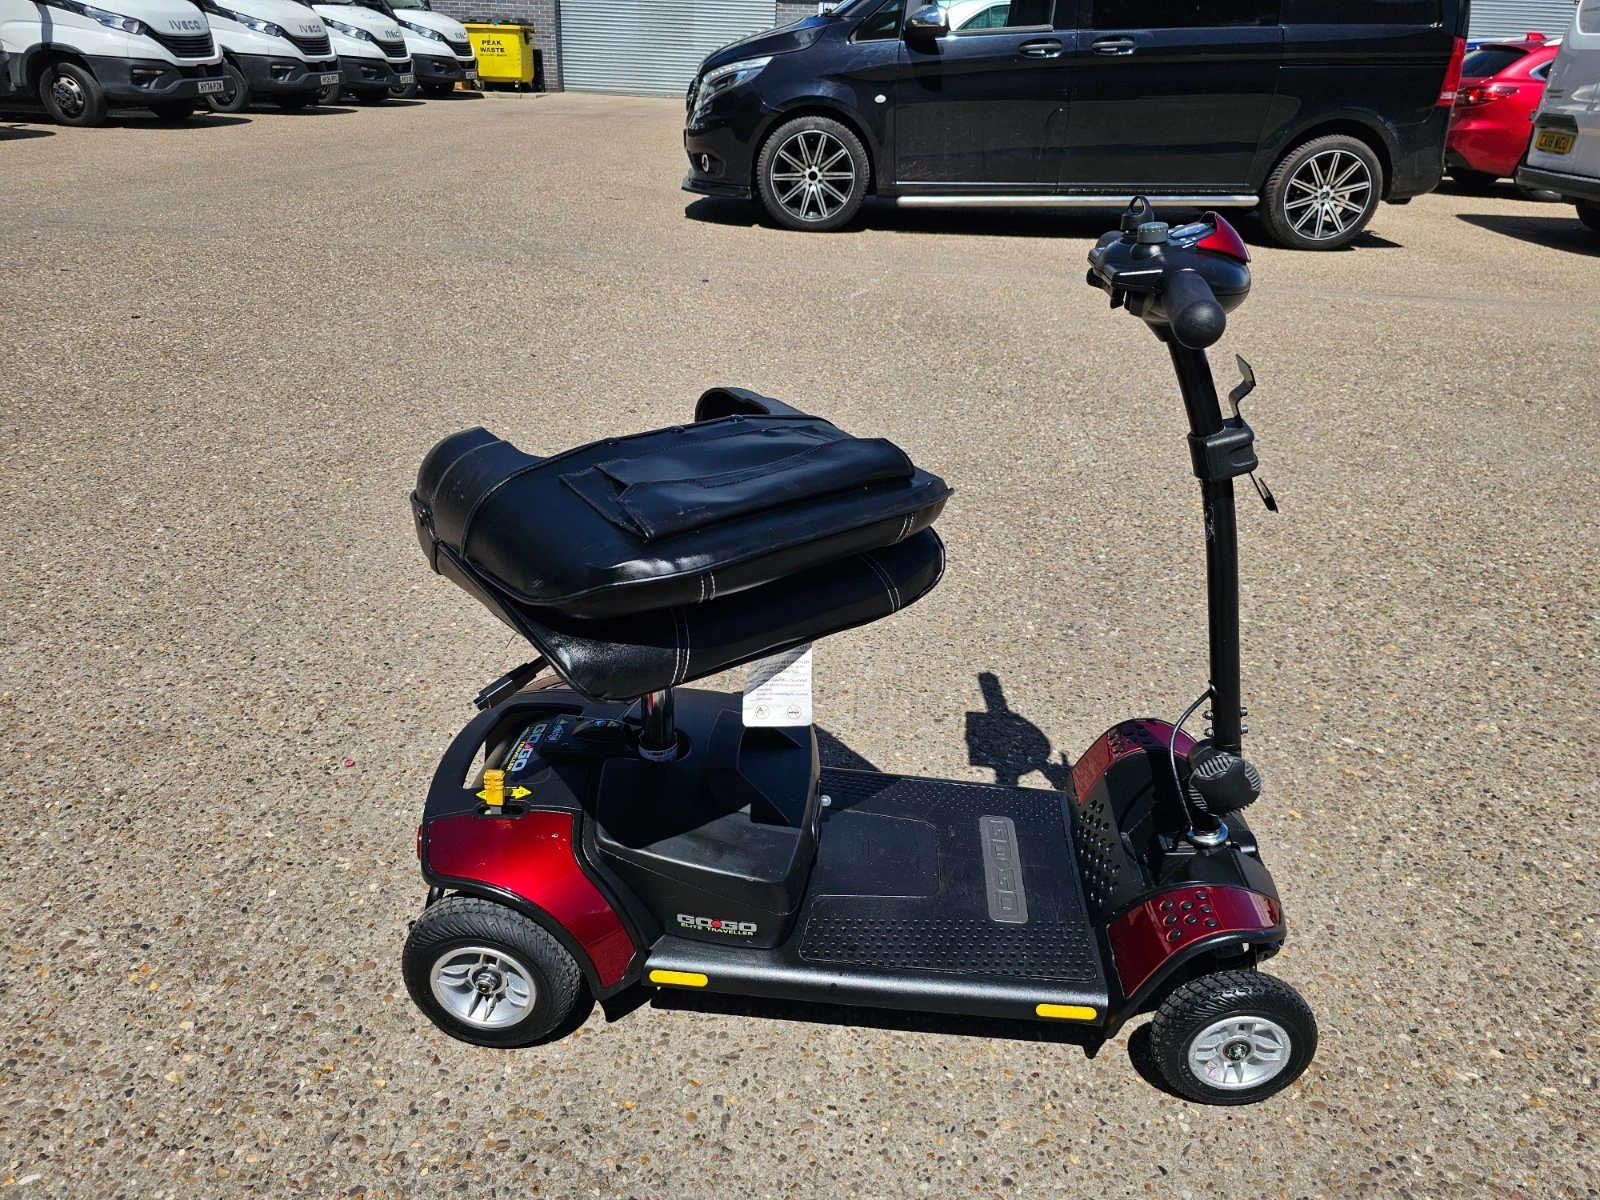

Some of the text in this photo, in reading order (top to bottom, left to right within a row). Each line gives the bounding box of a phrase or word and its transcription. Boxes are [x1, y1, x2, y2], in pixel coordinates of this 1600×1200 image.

[168, 19, 202, 30] IVECO
[298, 24, 322, 33] IVECO
[680, 922, 754, 936] ELITE TRAVELLER
